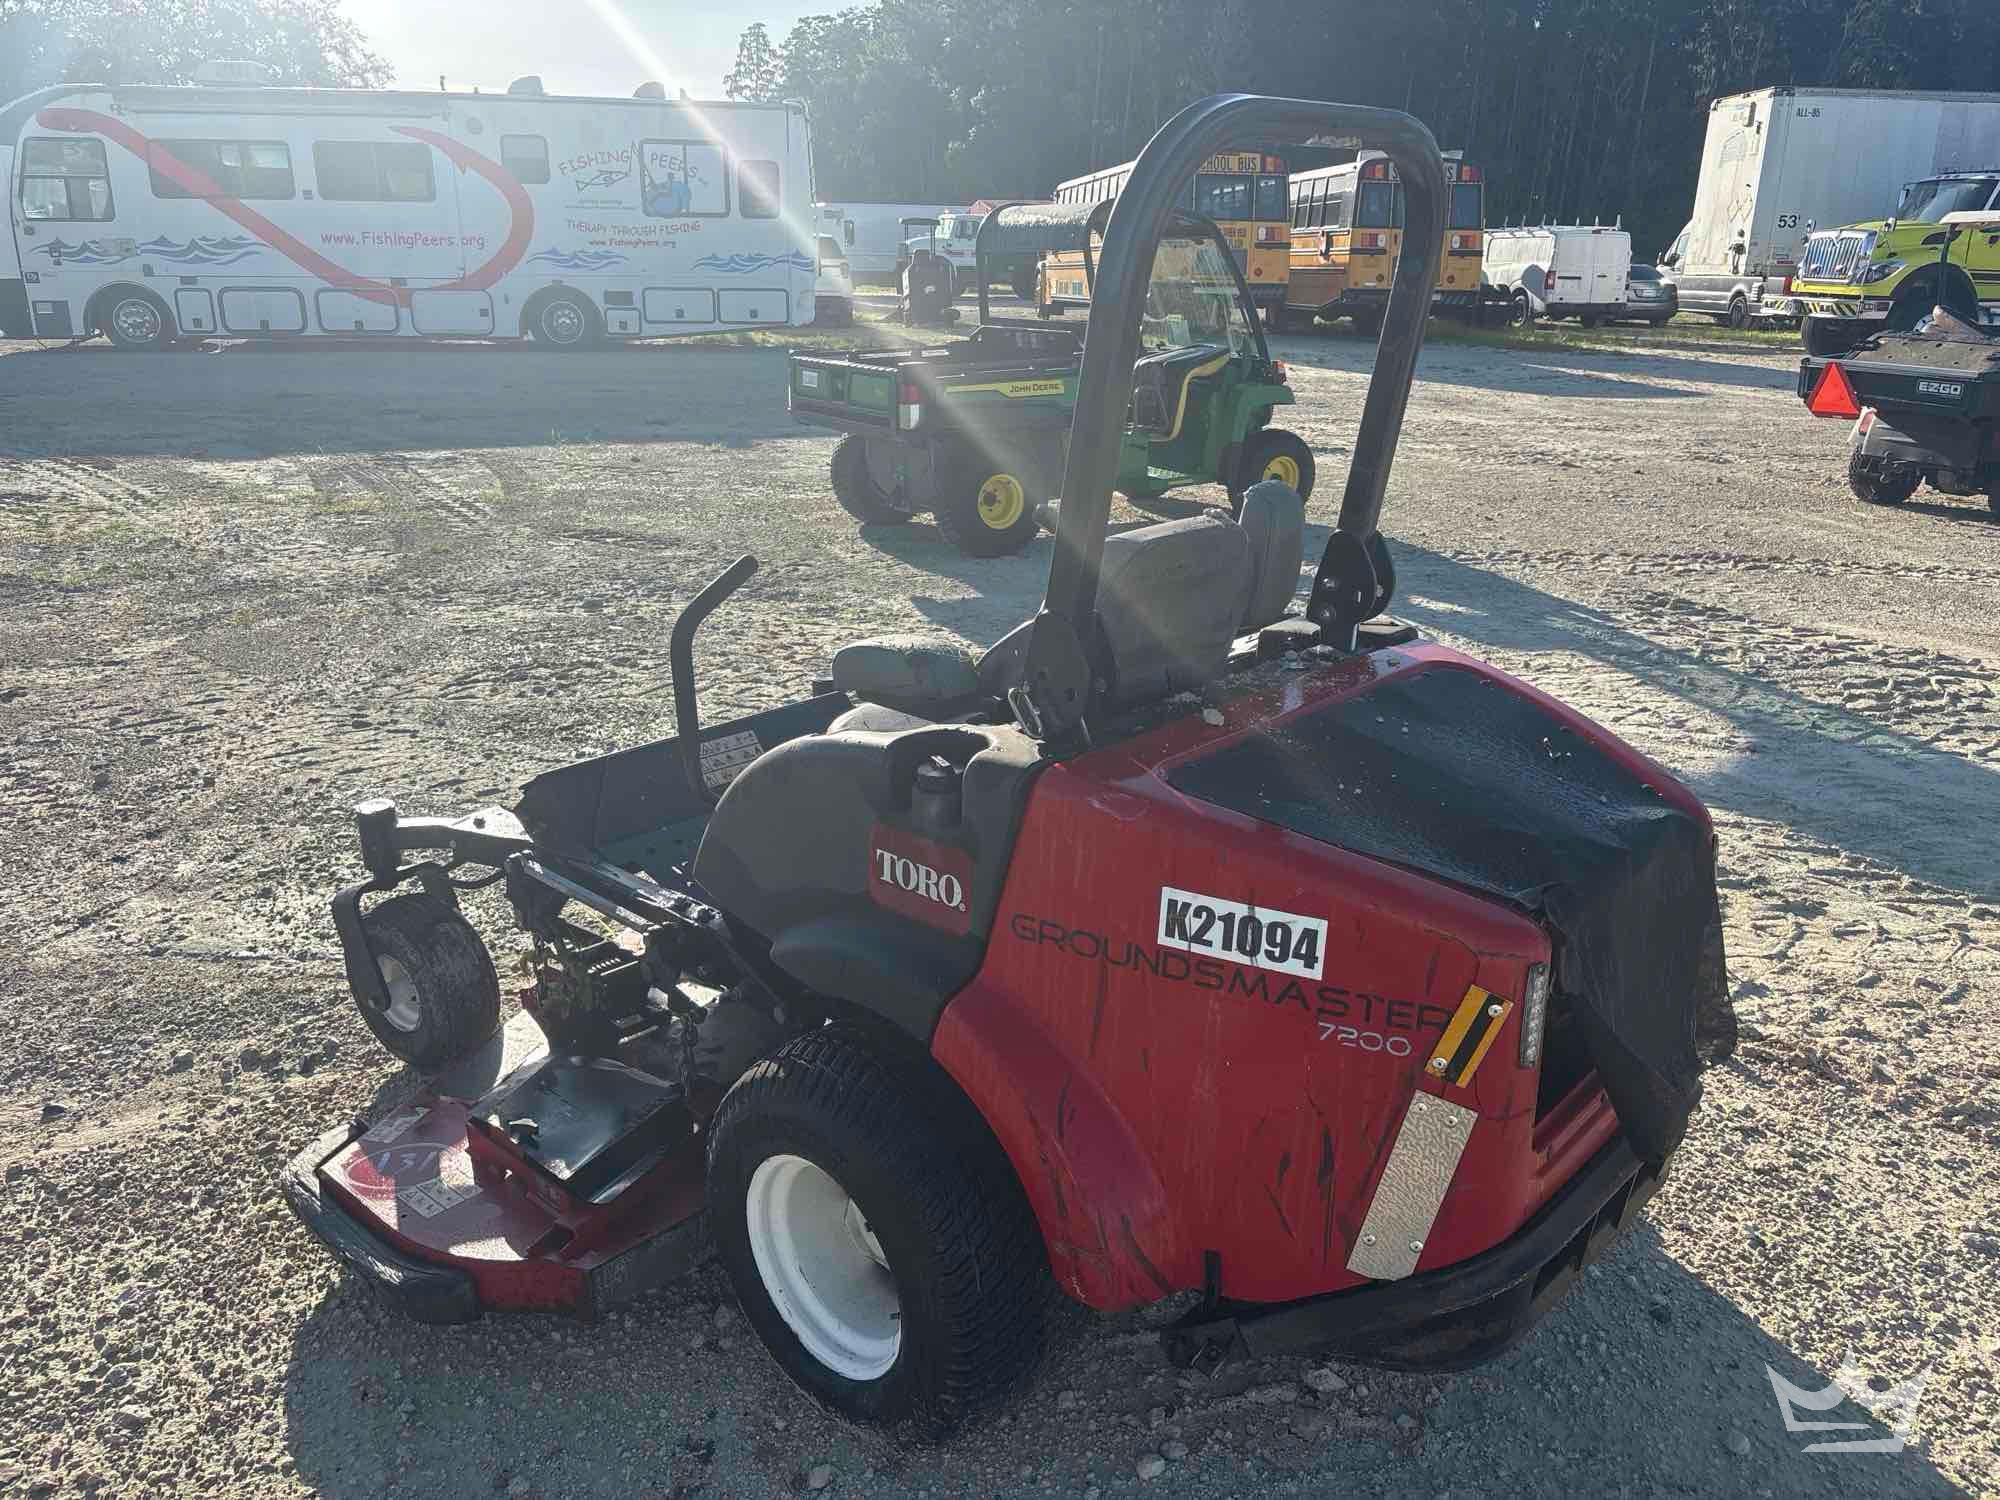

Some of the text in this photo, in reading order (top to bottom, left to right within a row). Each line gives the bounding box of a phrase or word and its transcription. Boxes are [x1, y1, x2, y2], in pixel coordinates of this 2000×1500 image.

[557, 150, 699, 178] FISHING PEERS
[1238, 156, 1257, 170] BUS
[320, 231, 485, 249] www.FishingPeers.org
[567, 219, 702, 237] THERAPY THROUGH FISHING
[1009, 383, 1061, 393] JOHN DEERE
[876, 848, 963, 909] TORO
[1164, 898, 1320, 970] K21094
[1010, 912, 1454, 1032] GROUNDSMASTER
[1317, 1021, 1412, 1057] 7200
